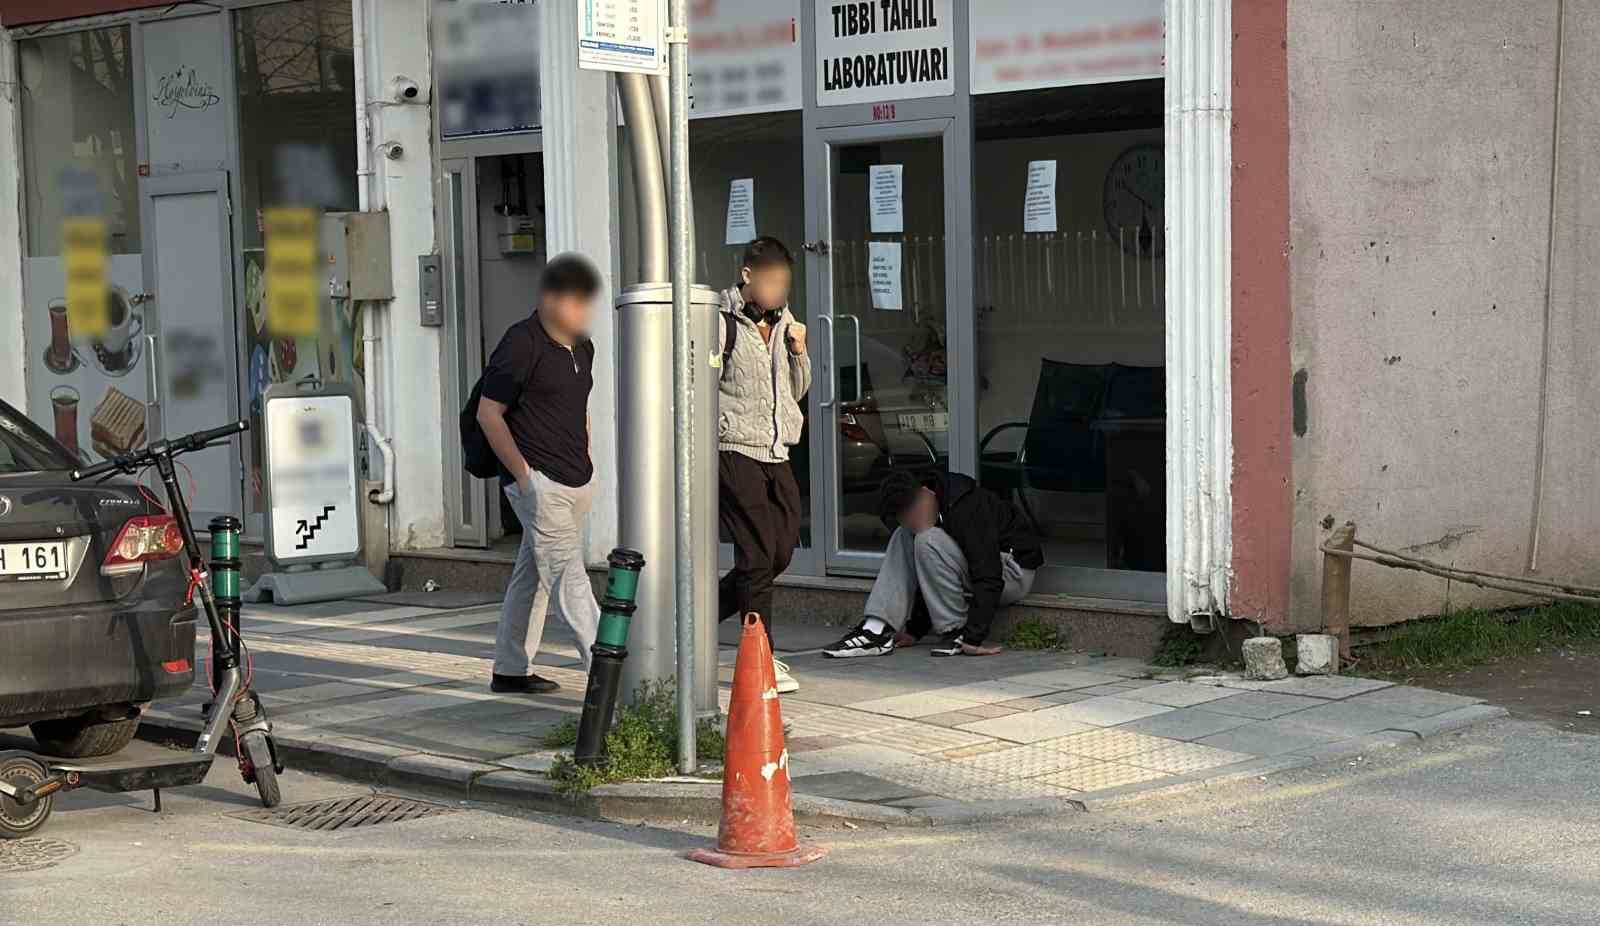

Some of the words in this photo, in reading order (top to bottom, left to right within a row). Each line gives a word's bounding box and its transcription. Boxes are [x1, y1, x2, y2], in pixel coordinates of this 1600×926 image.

[831, 1, 876, 38] TIBBI
[824, 47, 948, 91] LABORATUVARI
[22, 546, 59, 569] 161
